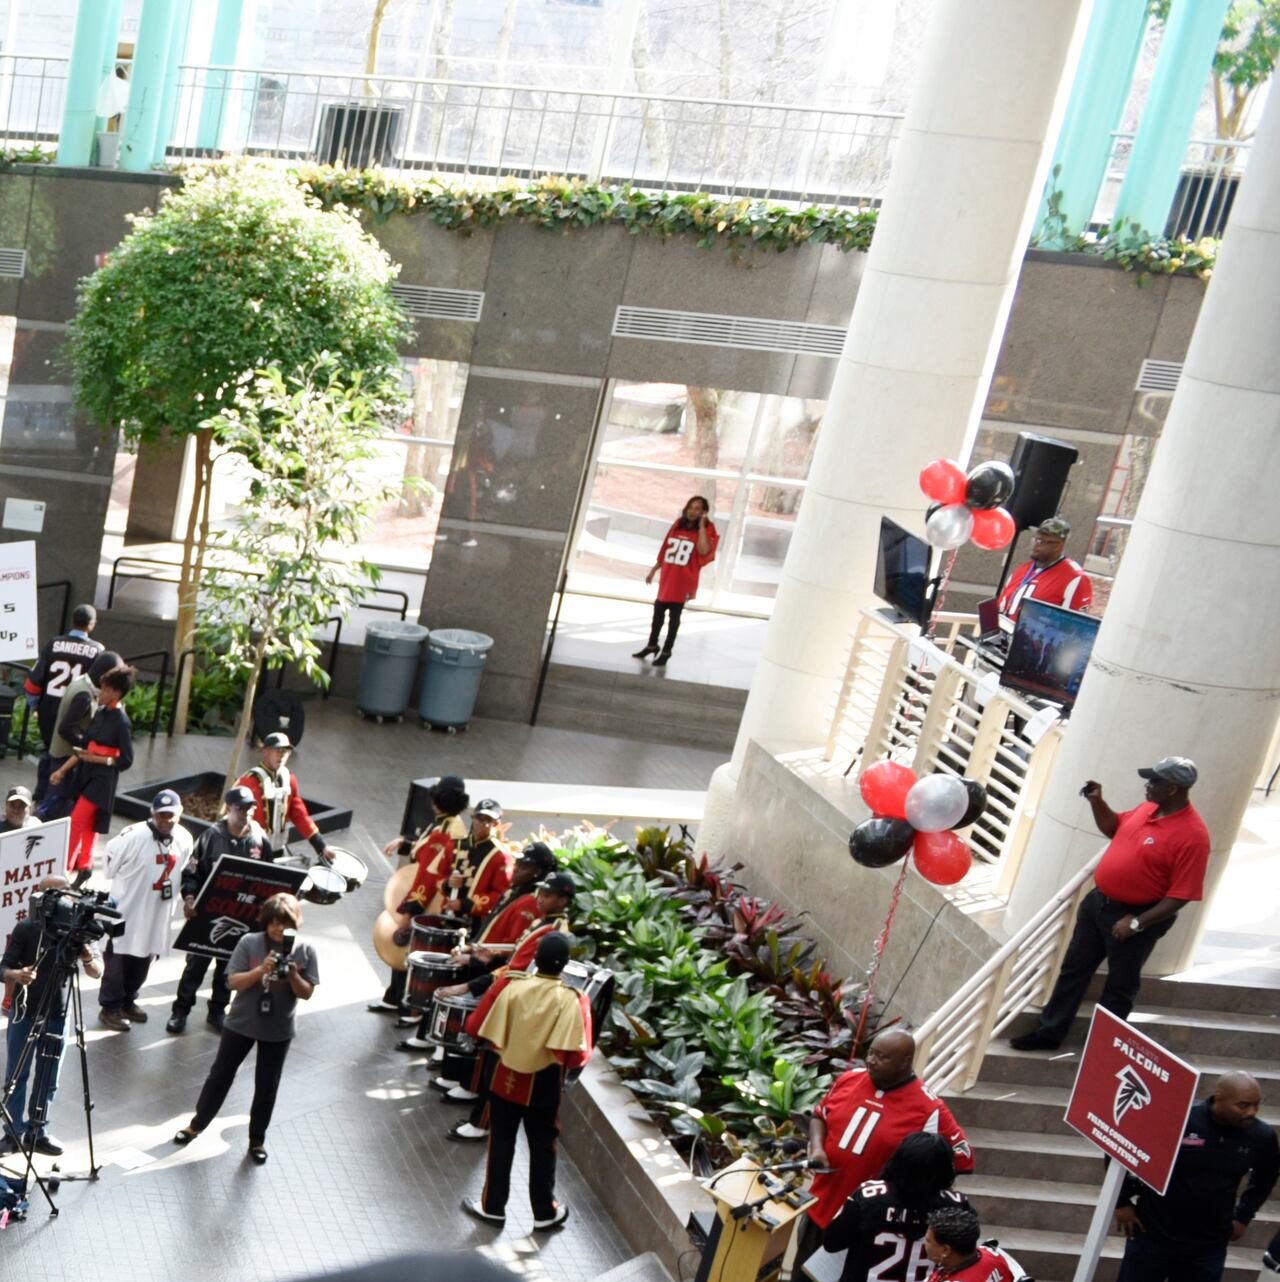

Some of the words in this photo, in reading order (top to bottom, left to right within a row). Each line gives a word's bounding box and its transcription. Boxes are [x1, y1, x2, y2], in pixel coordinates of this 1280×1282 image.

[664, 538, 695, 566] 28
[52, 640, 99, 660] SANDERS
[4, 858, 57, 886] MATT
[152, 854, 177, 891] 7
[1113, 1037, 1170, 1083] FALCONS
[838, 1105, 882, 1156] 11
[1137, 1147, 1152, 1163] GOT
